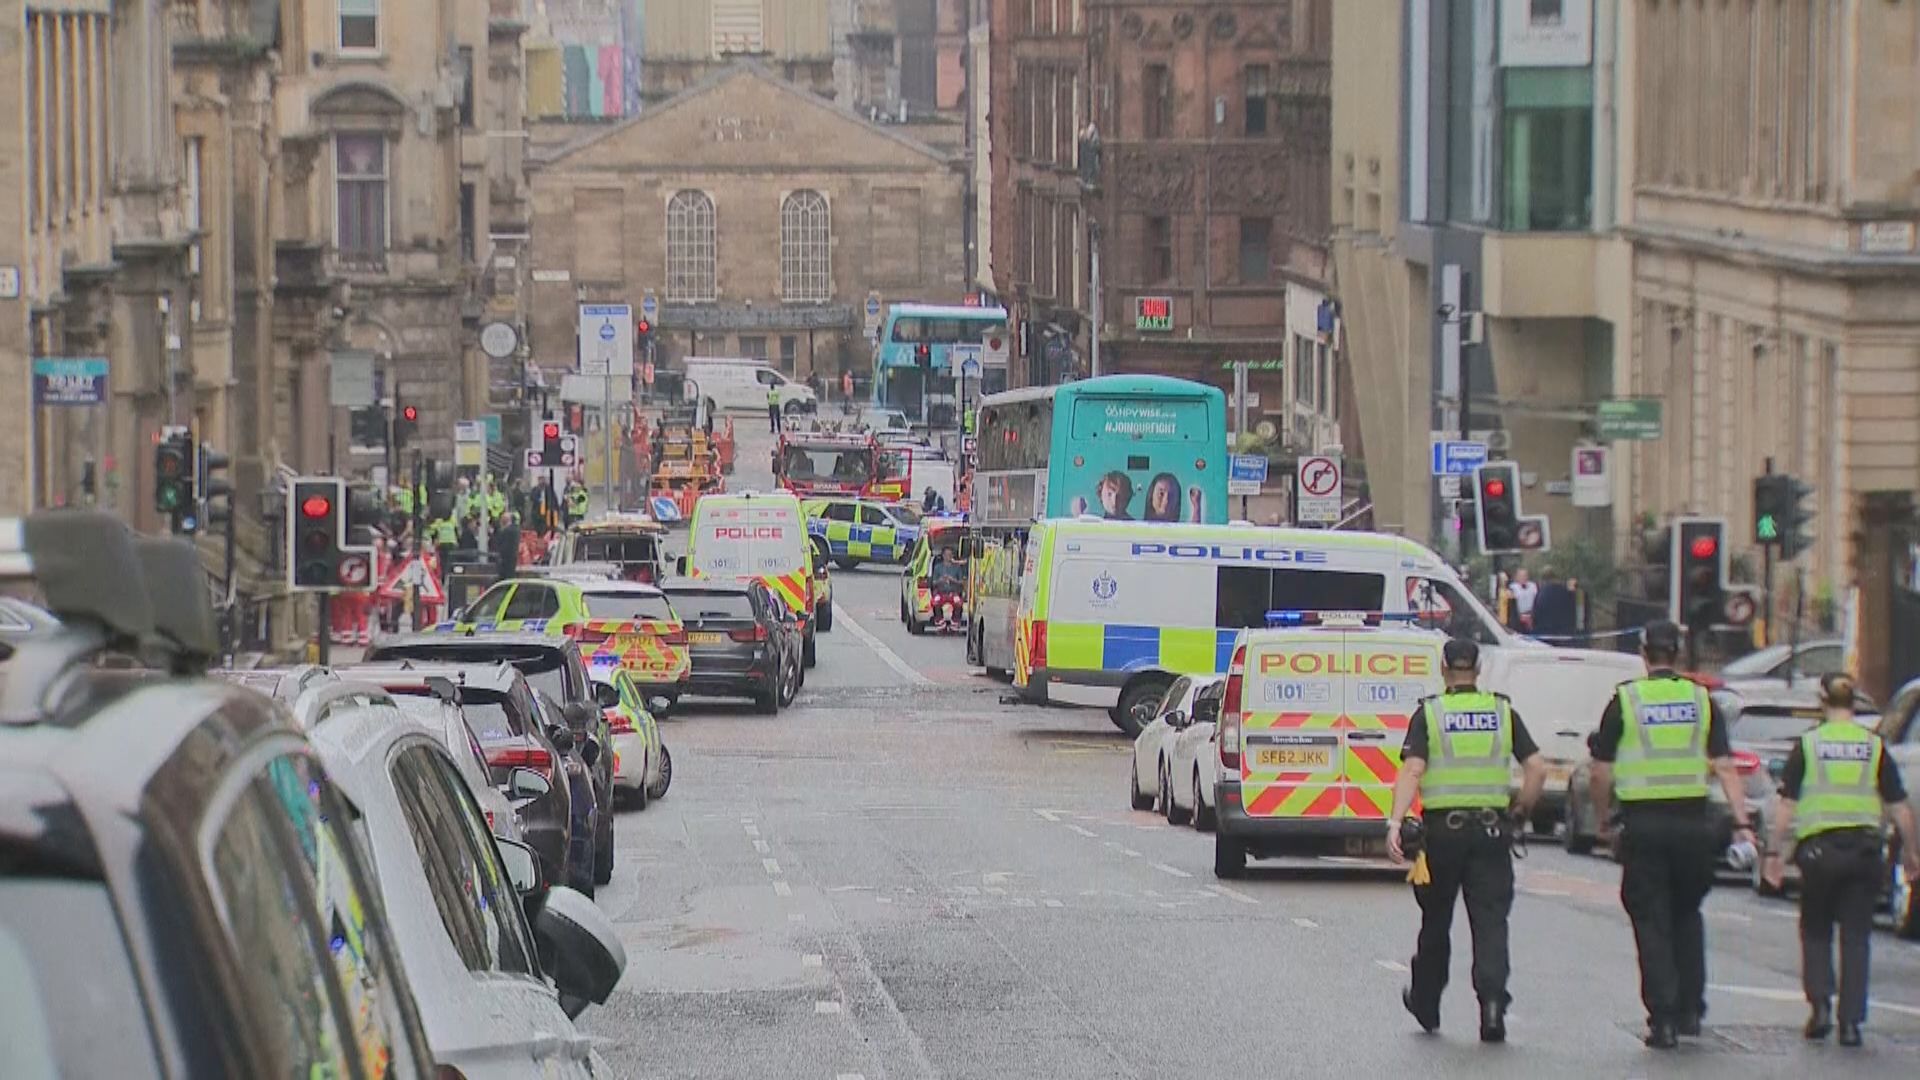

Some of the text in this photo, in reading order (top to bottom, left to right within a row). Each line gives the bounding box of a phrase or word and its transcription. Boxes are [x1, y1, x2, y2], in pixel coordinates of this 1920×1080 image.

[716, 527, 783, 539] POLICE
[1131, 543, 1327, 563] POLICE
[714, 559, 727, 568] 101
[764, 559, 777, 568] 101
[1321, 612, 1365, 620] POLICE
[1260, 653, 1429, 675] POLICE
[1276, 683, 1303, 700] 101
[1370, 686, 1397, 701] 101
[1642, 703, 1697, 724] POLICE
[1445, 713, 1498, 731] POLICE
[1261, 751, 1324, 766] SF62 JKK
[1818, 743, 1873, 760] POLICE
